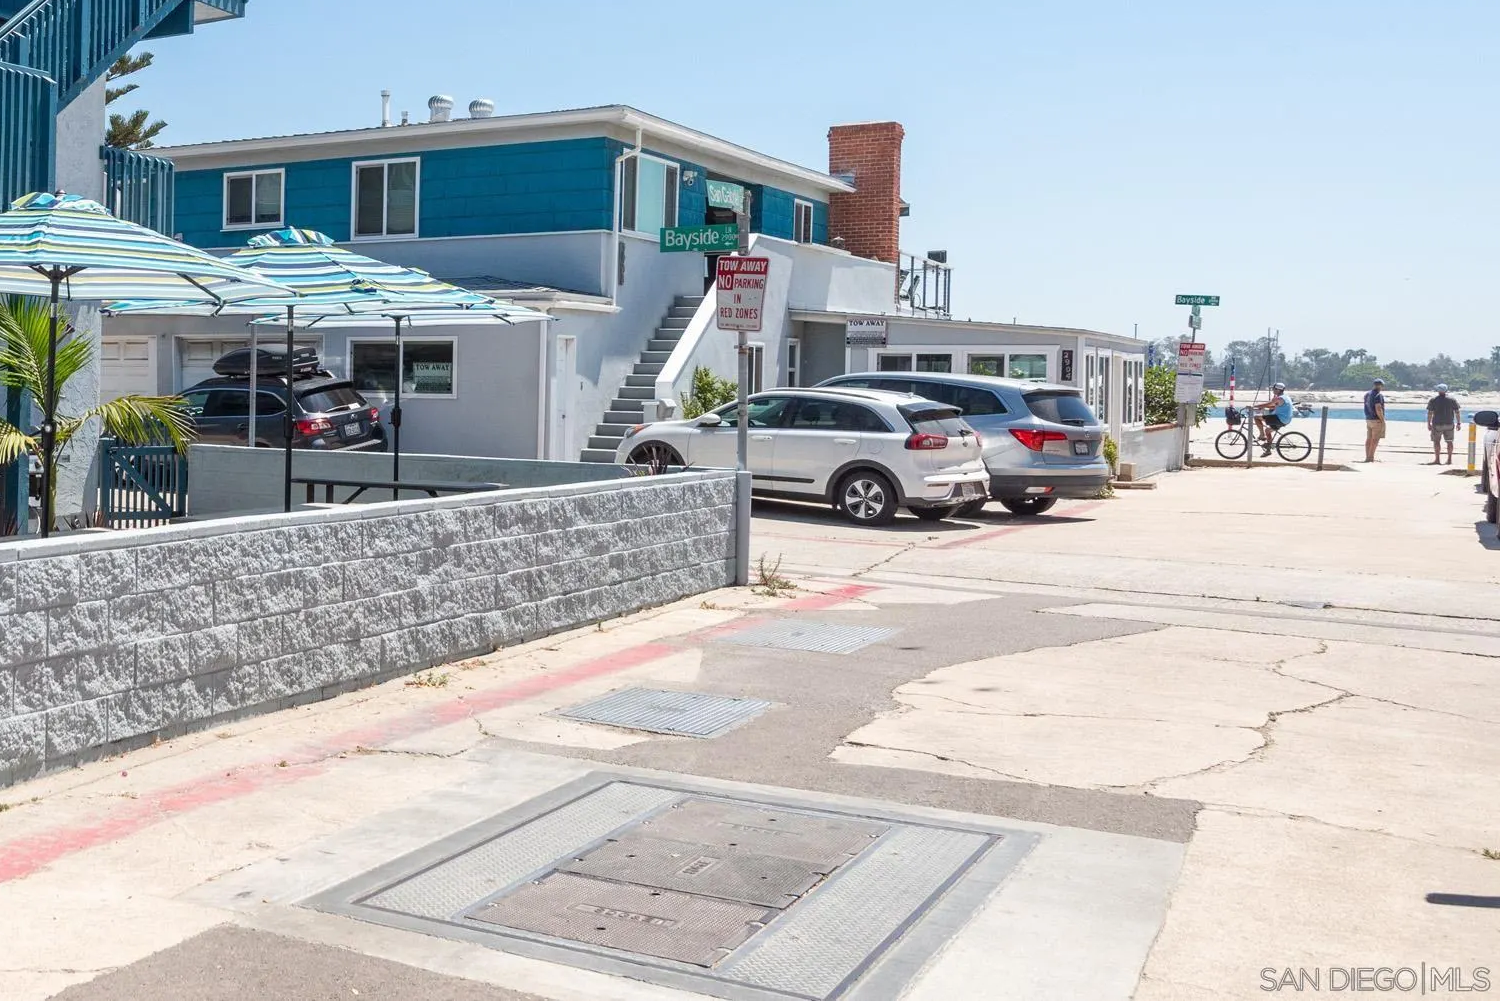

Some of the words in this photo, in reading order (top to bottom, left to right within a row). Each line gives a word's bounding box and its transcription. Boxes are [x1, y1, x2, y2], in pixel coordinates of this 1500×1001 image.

[665, 228, 719, 250] Bayside
[720, 260, 739, 271] TOW
[740, 261, 767, 272] AWAY
[718, 274, 732, 289] NO
[734, 278, 764, 290] PARKING
[733, 293, 742, 304] IN
[1176, 295, 1206, 304] Bayside
[720, 307, 732, 318] RED
[735, 307, 758, 320] ZONES
